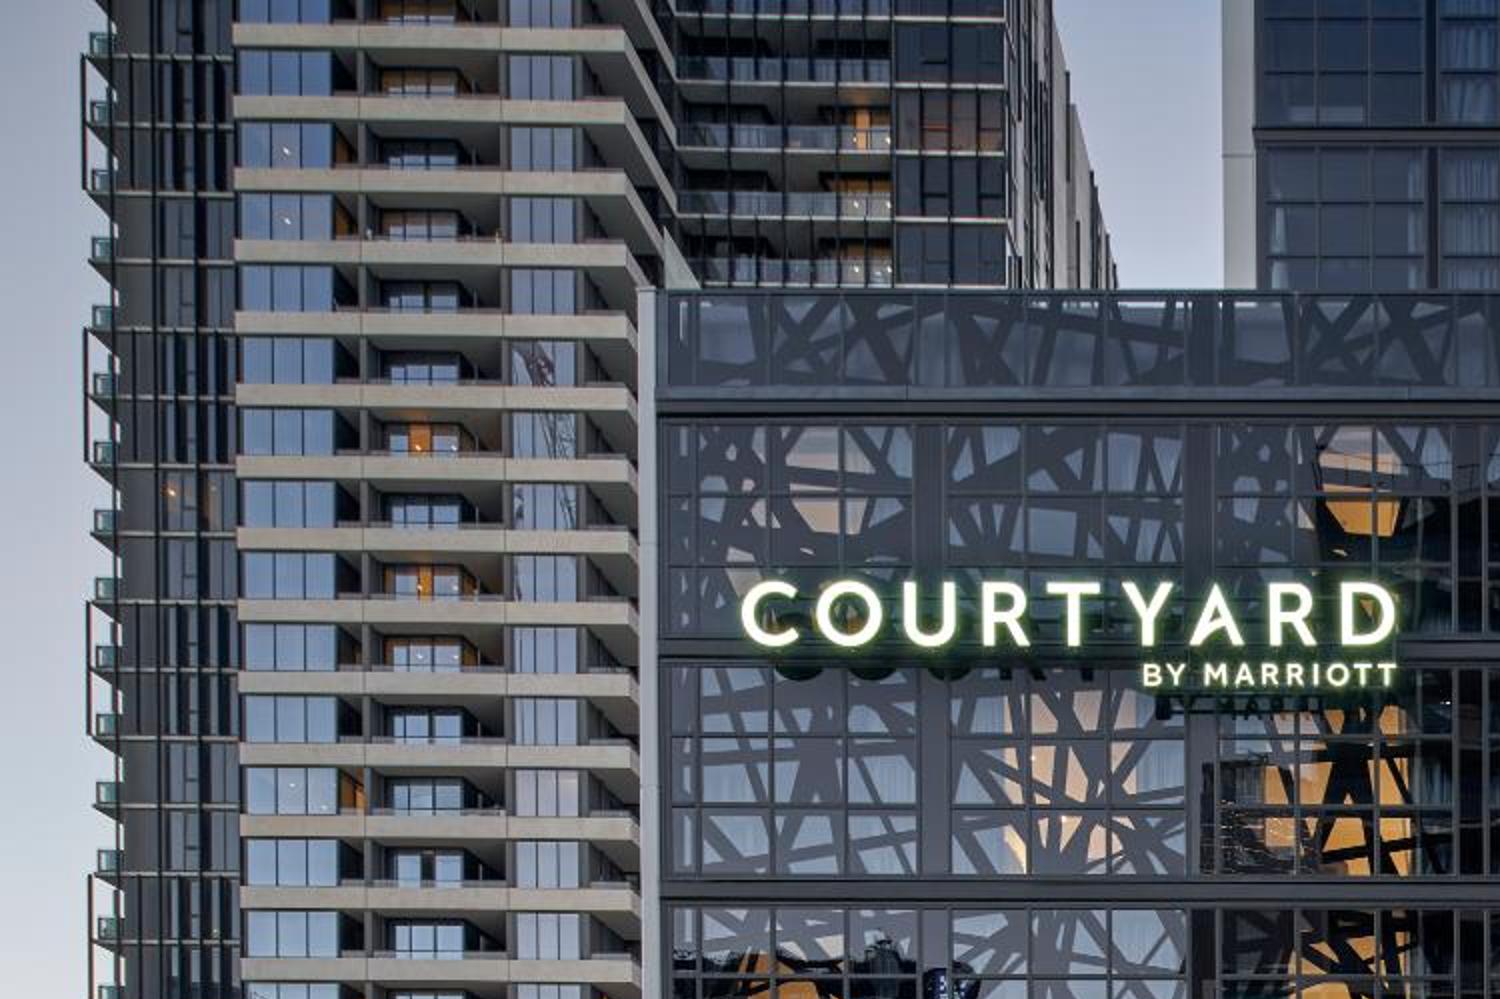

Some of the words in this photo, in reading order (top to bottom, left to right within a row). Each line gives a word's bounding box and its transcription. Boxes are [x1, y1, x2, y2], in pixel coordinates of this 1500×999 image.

[741, 579, 1396, 648] COURTYARD
[1143, 663, 1186, 687] BY
[1203, 663, 1397, 688] MARRIOTT
